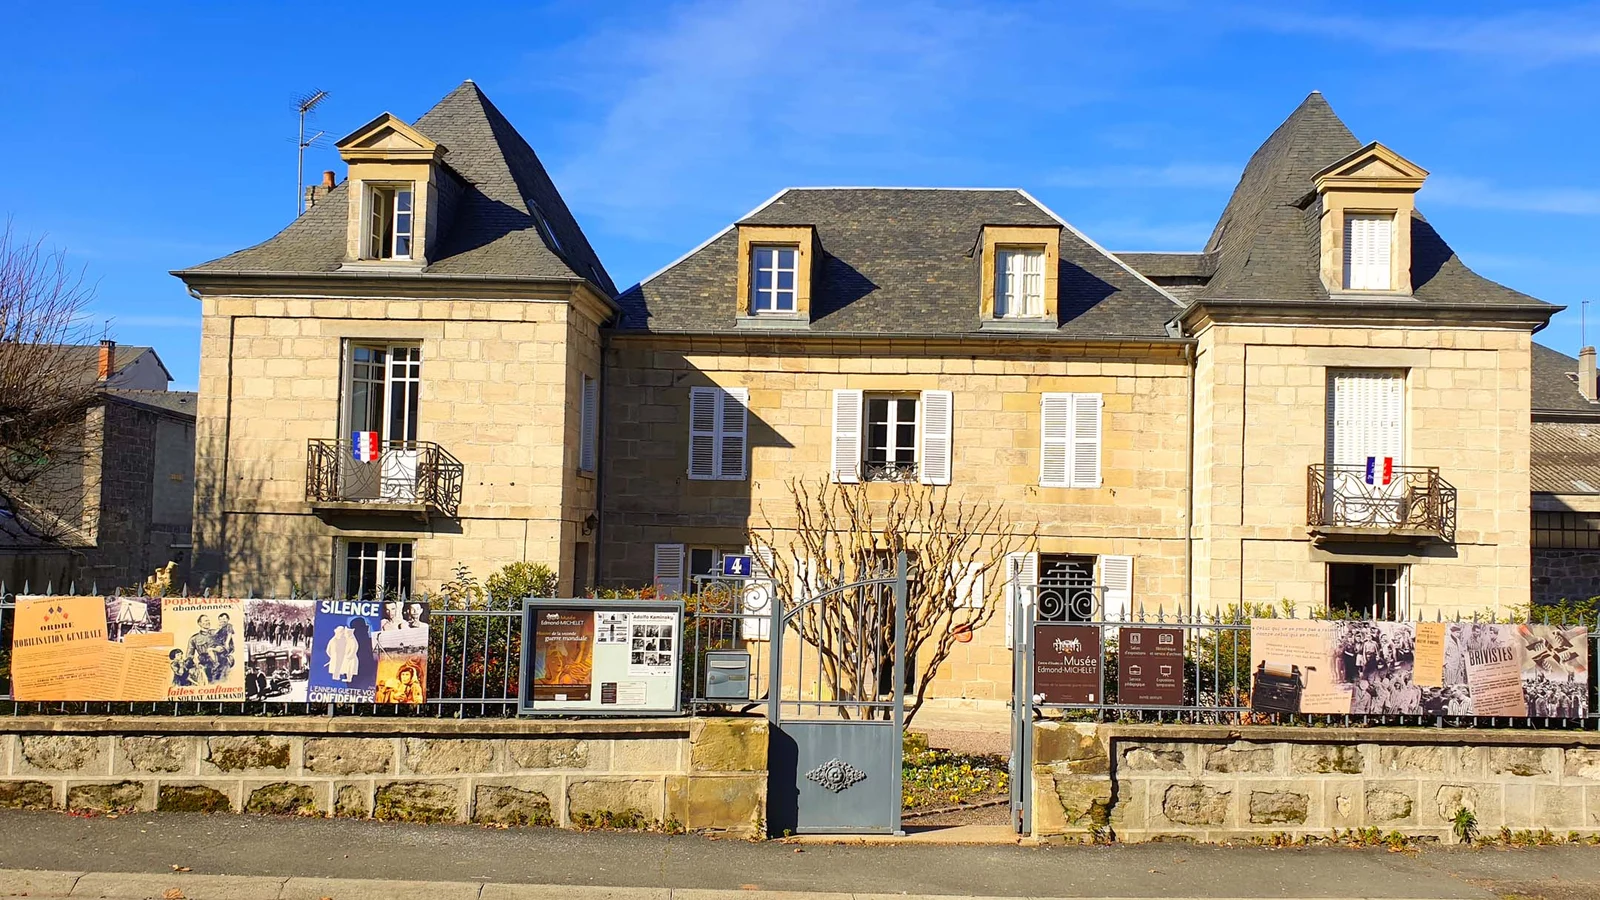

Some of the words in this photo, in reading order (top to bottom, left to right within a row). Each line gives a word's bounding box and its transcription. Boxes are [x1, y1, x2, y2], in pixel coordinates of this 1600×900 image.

[731, 558, 742, 574] 4
[164, 597, 240, 606] POPULATIONS
[321, 601, 379, 616] SILENCE
[40, 622, 75, 631] ORDRE
[14, 633, 64, 648] MOBILISATION
[1064, 655, 1097, 666] Musée
[1468, 646, 1513, 666] BRIVISTES
[168, 687, 194, 696] faites
[198, 685, 243, 694] confiance
[338, 687, 361, 695] GUETTE
[362, 689, 376, 697] VOS
[309, 692, 374, 703] CONFIDENCES
